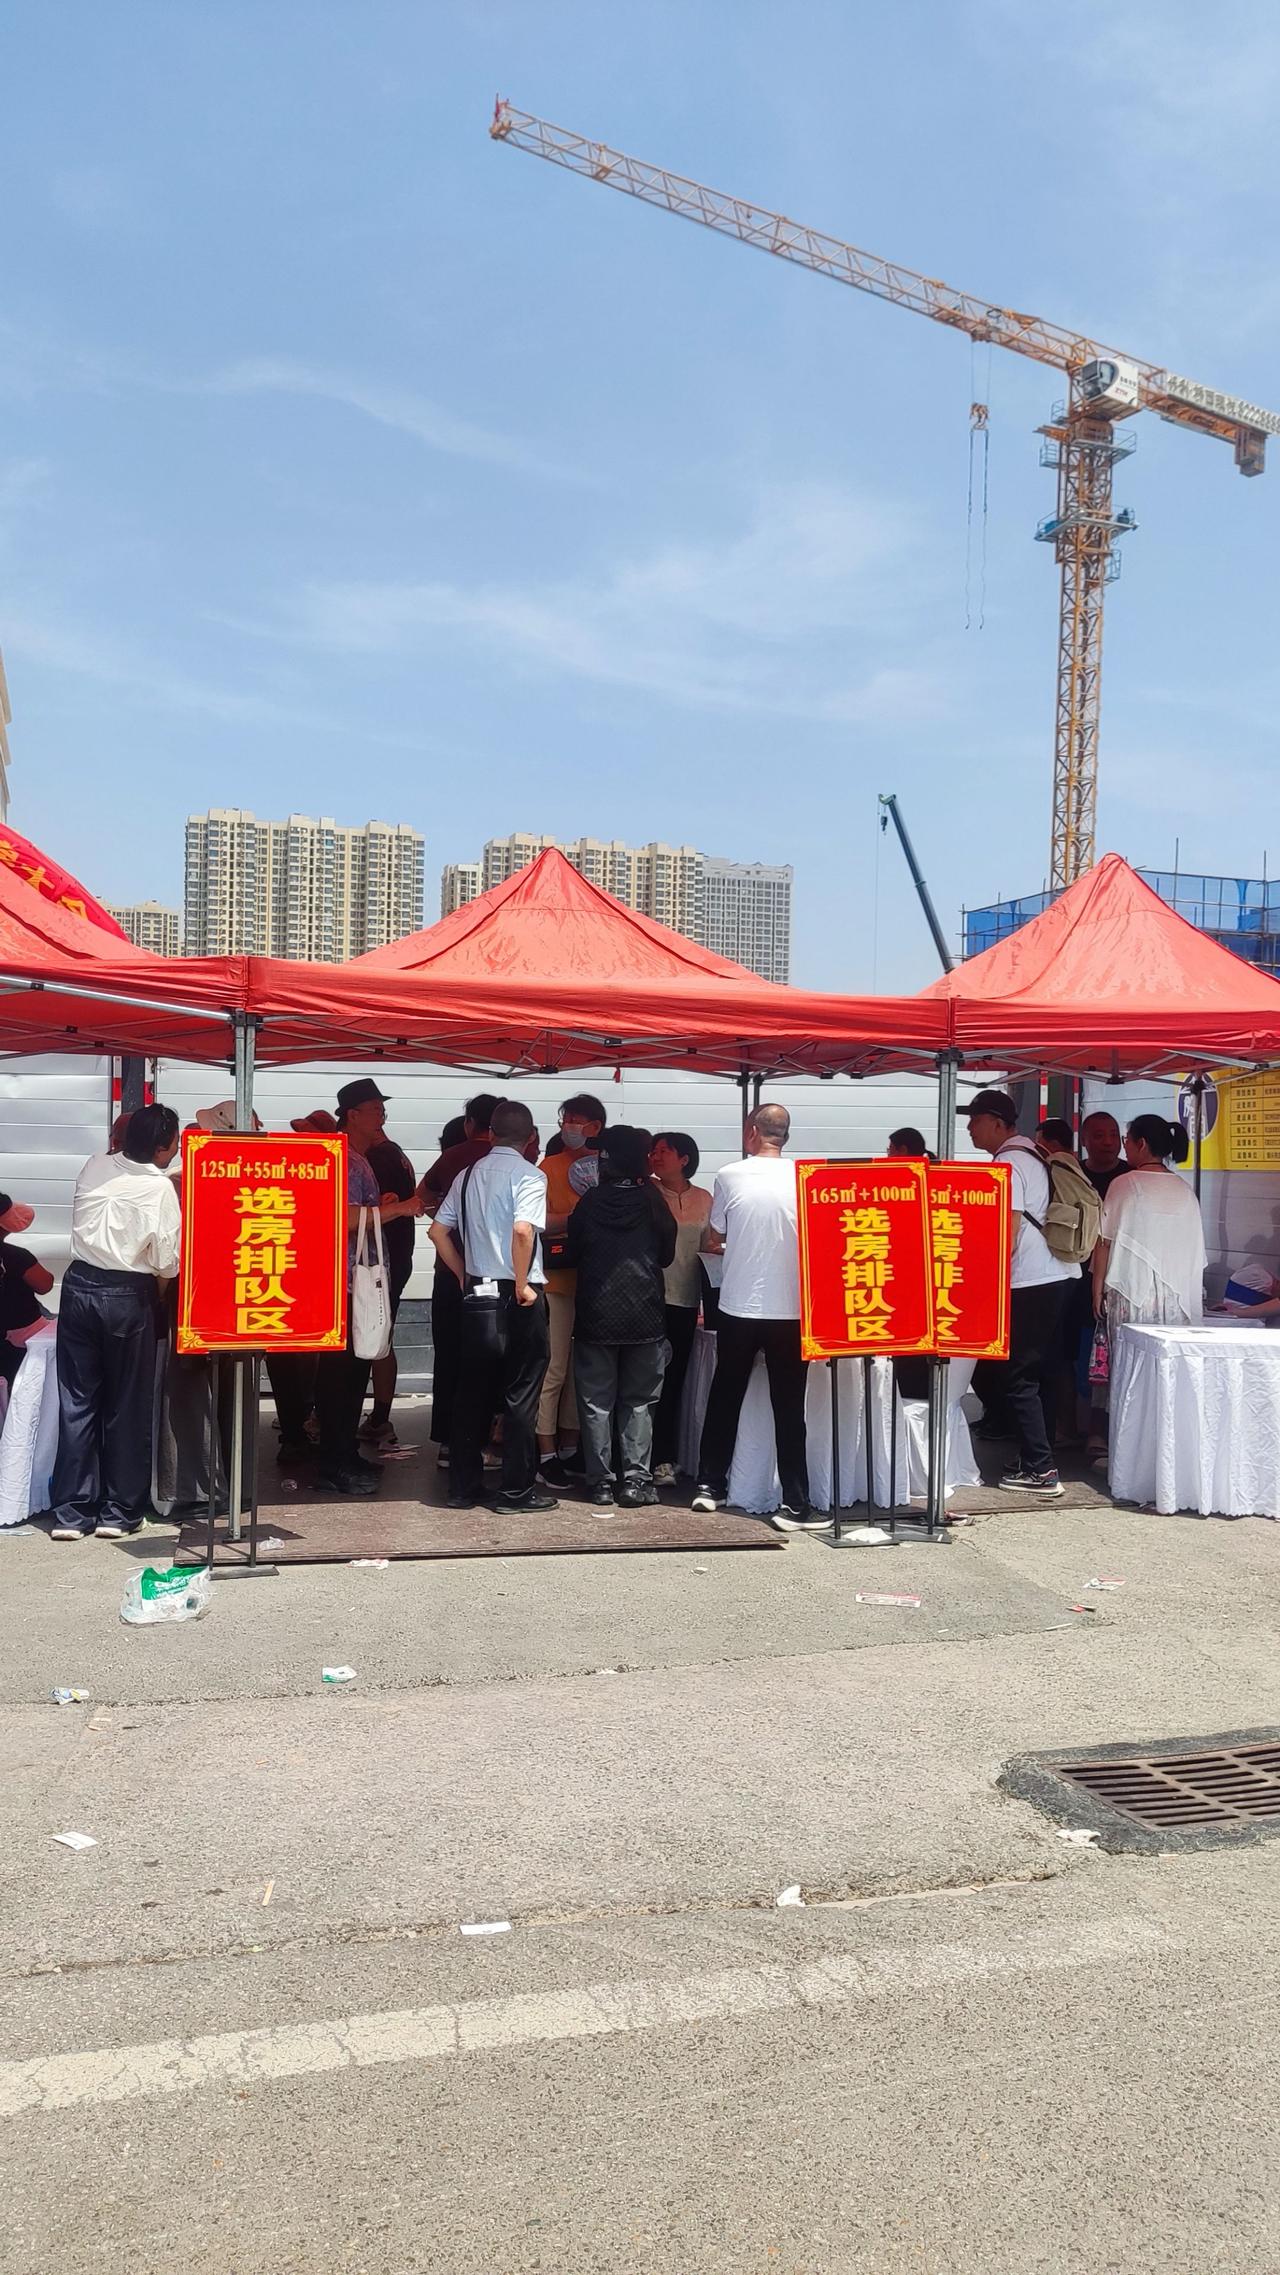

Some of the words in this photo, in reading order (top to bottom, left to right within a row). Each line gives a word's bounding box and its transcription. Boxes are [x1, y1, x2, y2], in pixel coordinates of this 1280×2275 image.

[233, 1186, 298, 1334] 选房排队区
[838, 1207, 896, 1341] 选房排队区
